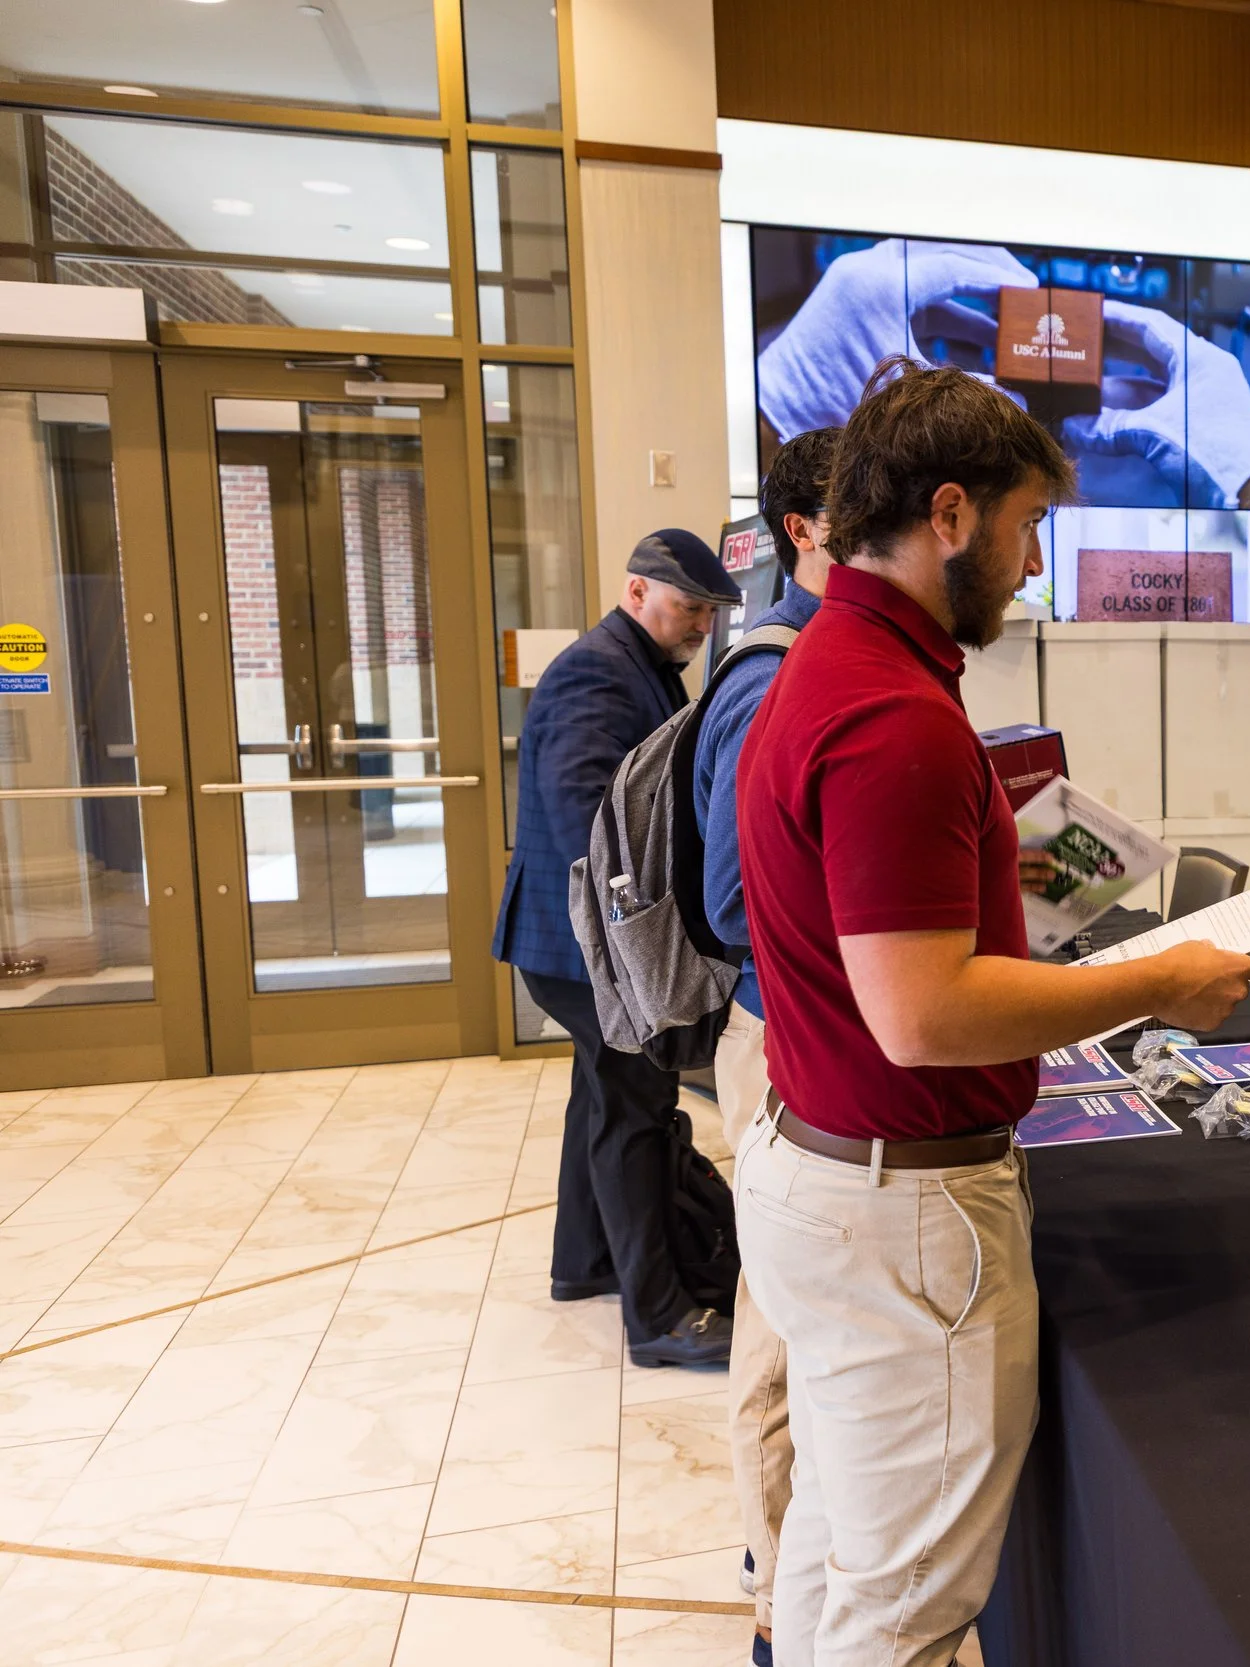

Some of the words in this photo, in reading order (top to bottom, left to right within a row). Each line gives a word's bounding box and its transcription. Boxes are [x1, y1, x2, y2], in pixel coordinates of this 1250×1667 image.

[1013, 343, 1039, 357] USC
[1040, 346, 1086, 361] Alumni
[723, 528, 758, 573] CSRI
[1131, 573, 1183, 590] COCKY
[1102, 595, 1151, 613] CLASS
[1156, 596, 1176, 613] OF
[0, 643, 44, 652] AUTION
